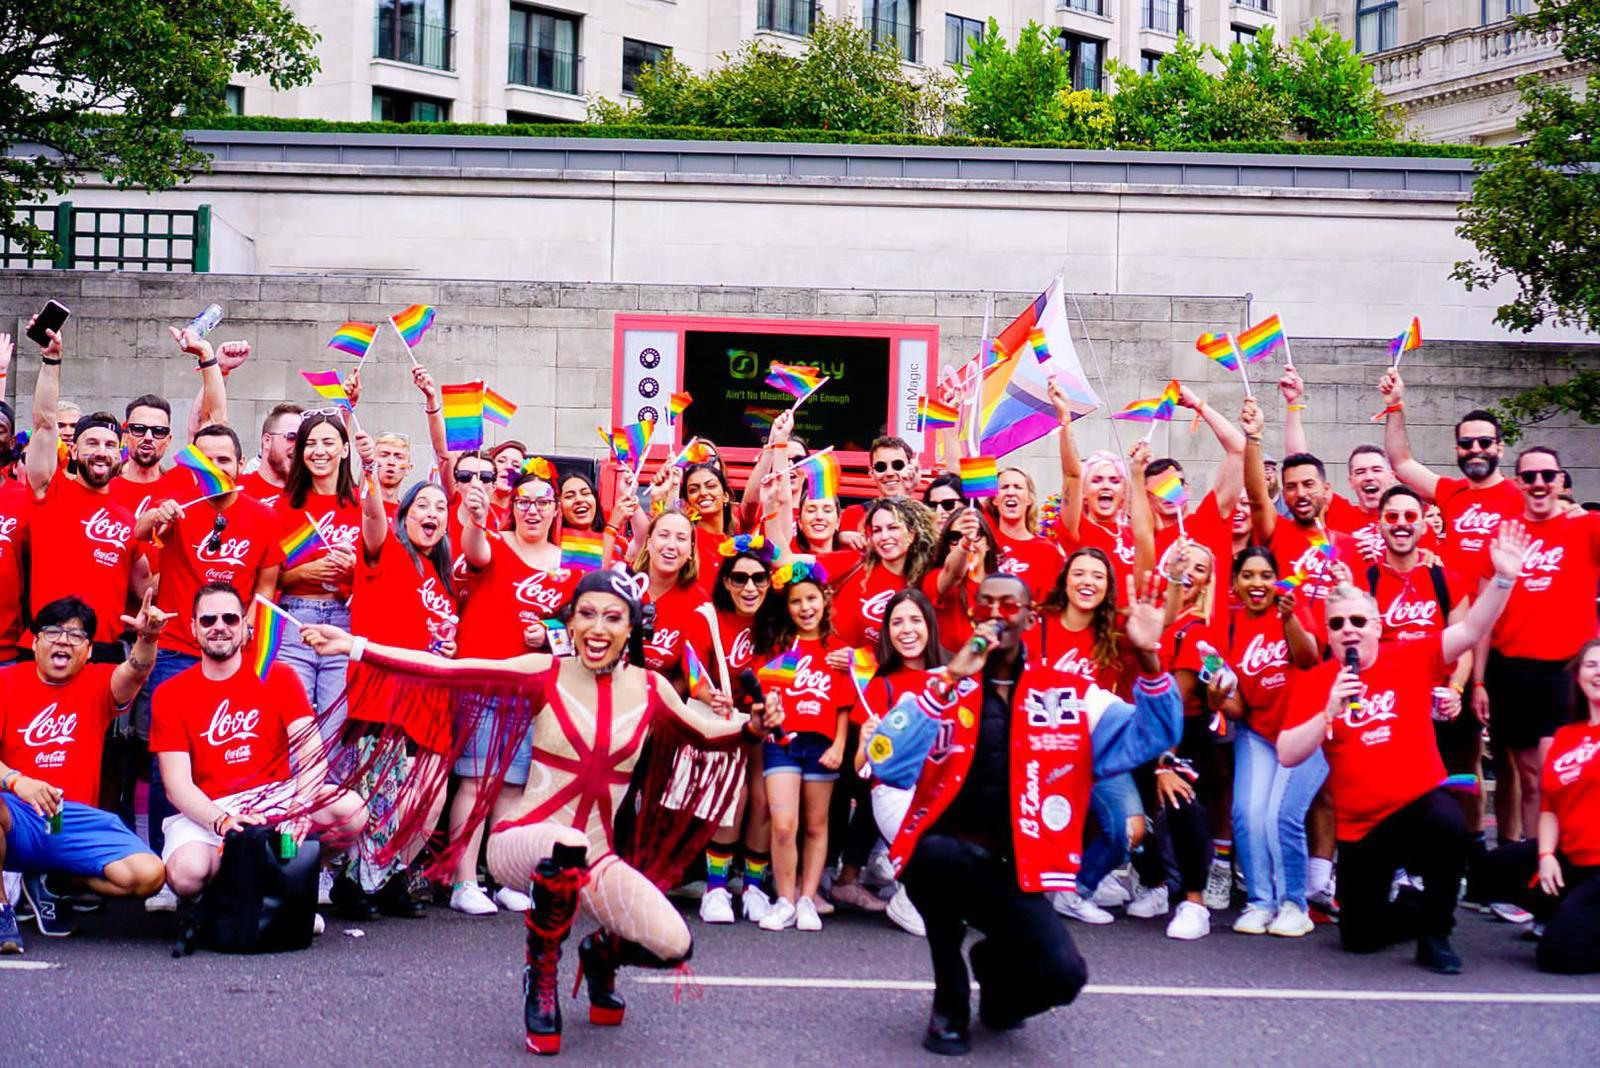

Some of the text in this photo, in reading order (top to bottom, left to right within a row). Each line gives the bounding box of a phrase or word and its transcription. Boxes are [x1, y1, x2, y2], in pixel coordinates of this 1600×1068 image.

[725, 390, 745, 400] Ain't
[747, 390, 758, 400] No
[820, 393, 850, 404] Enough
[905, 363, 921, 431] Real Magic
